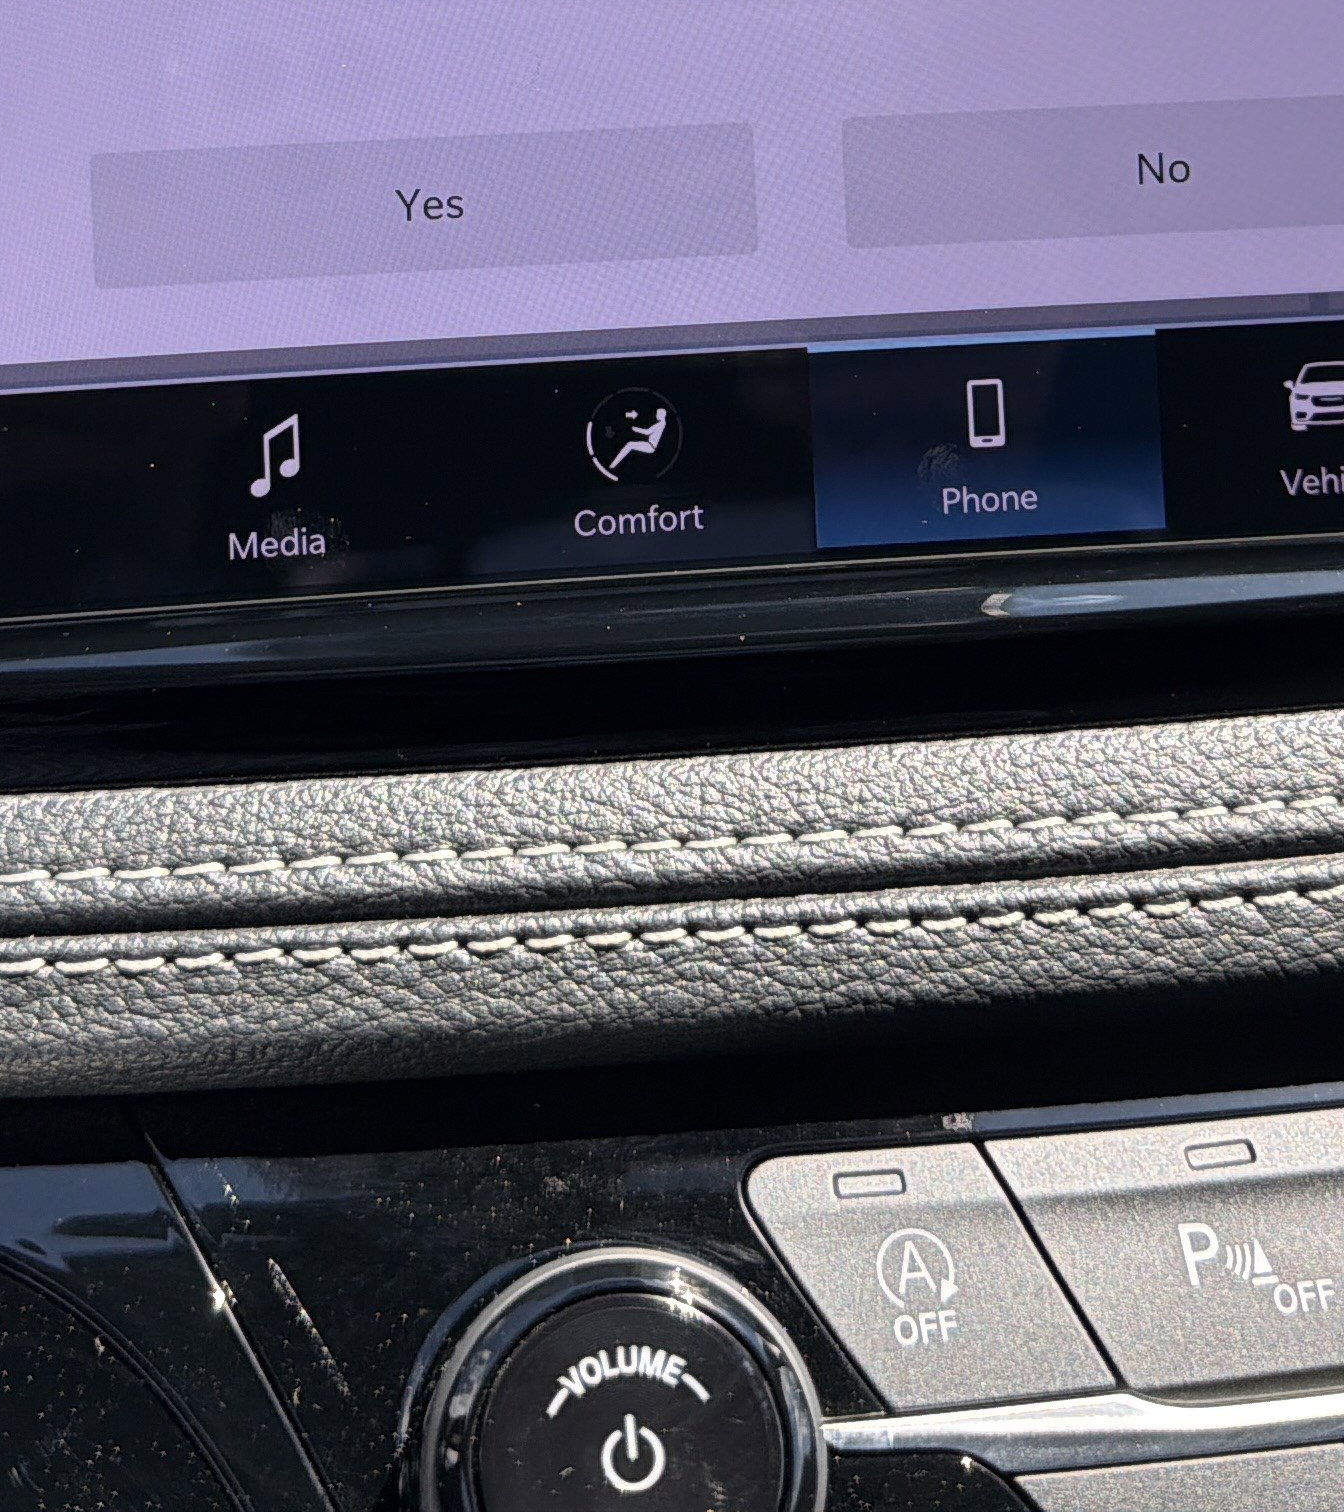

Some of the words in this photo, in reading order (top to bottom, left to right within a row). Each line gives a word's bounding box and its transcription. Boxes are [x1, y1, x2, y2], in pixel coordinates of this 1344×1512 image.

[1137, 152, 1190, 185] No
[395, 188, 464, 222] Yes
[942, 484, 1039, 515] Phone
[574, 503, 704, 537] Comfort
[228, 526, 326, 561] Media
[1273, 1278, 1334, 1315] OFF
[893, 1310, 957, 1346] OFF
[558, 1345, 689, 1398] VOLUME
